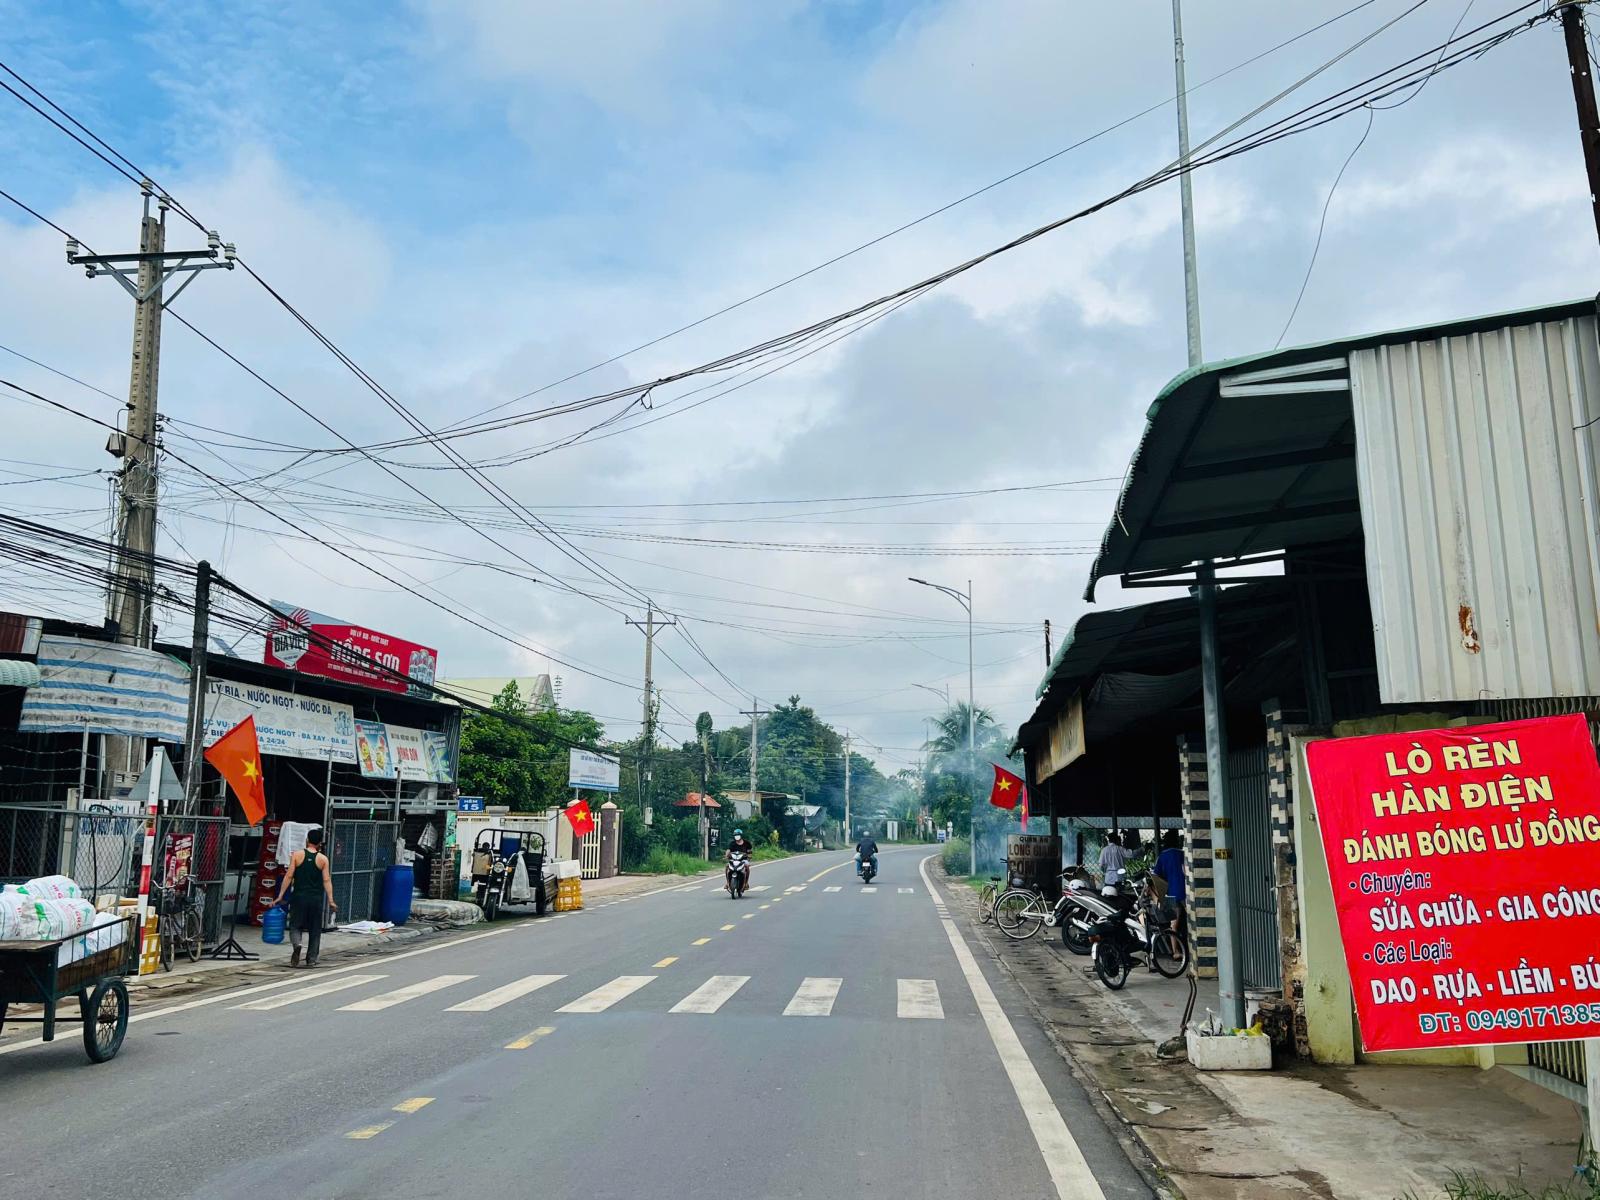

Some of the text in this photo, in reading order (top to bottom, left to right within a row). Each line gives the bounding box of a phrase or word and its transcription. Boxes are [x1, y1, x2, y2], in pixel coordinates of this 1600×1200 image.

[225, 686, 240, 698] BIA
[248, 688, 270, 704] NƯỚC
[272, 695, 294, 710] NGỌT
[1386, 737, 1521, 776] LÒ RÈN
[1372, 774, 1554, 817] HÀN ĐIỆN
[1008, 844, 1031, 856] LONG
[1343, 808, 1600, 864] ĐÁNH BÓNG LƯ ĐỒNG
[1360, 868, 1432, 896] Chuyên:
[1369, 886, 1600, 932] SỬA CHỮA GIA CÔNG
[1374, 937, 1452, 965] Các Loại:
[1370, 977, 1416, 1005] DAO
[1432, 968, 1482, 1006] RỰA
[1497, 958, 1554, 997] LIỀM
[1419, 1003, 1600, 1034] ĐT: 0949171385
